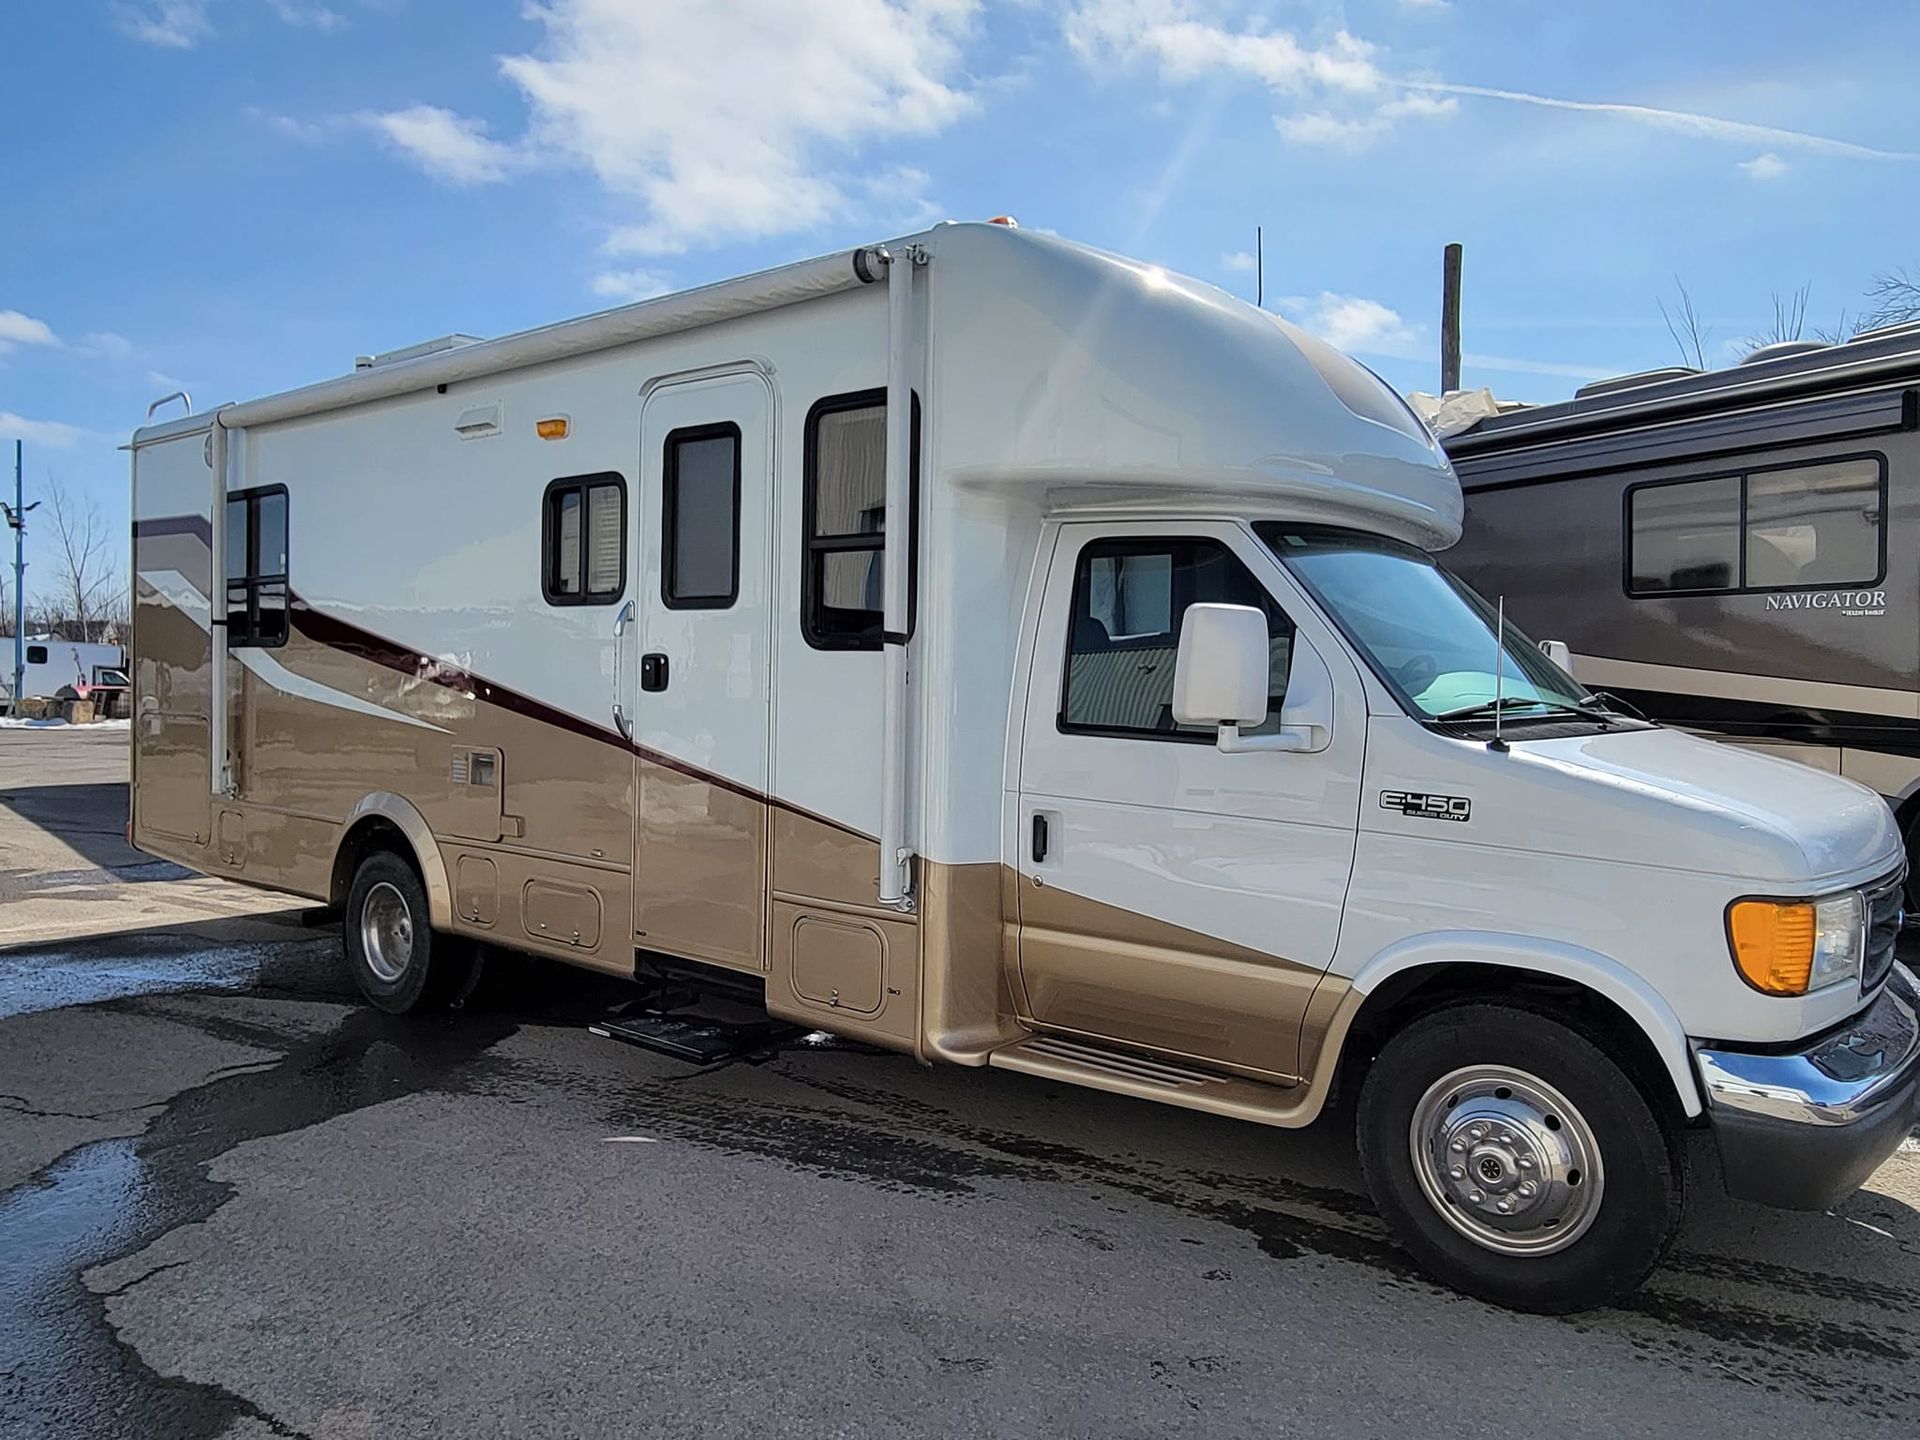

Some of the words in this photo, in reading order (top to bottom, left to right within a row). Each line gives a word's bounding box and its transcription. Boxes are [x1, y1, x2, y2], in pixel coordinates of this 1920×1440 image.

[1765, 591, 1886, 610] NAVIGATOR
[1406, 809, 1438, 818] SUPER
[1439, 813, 1466, 821] DUTY
